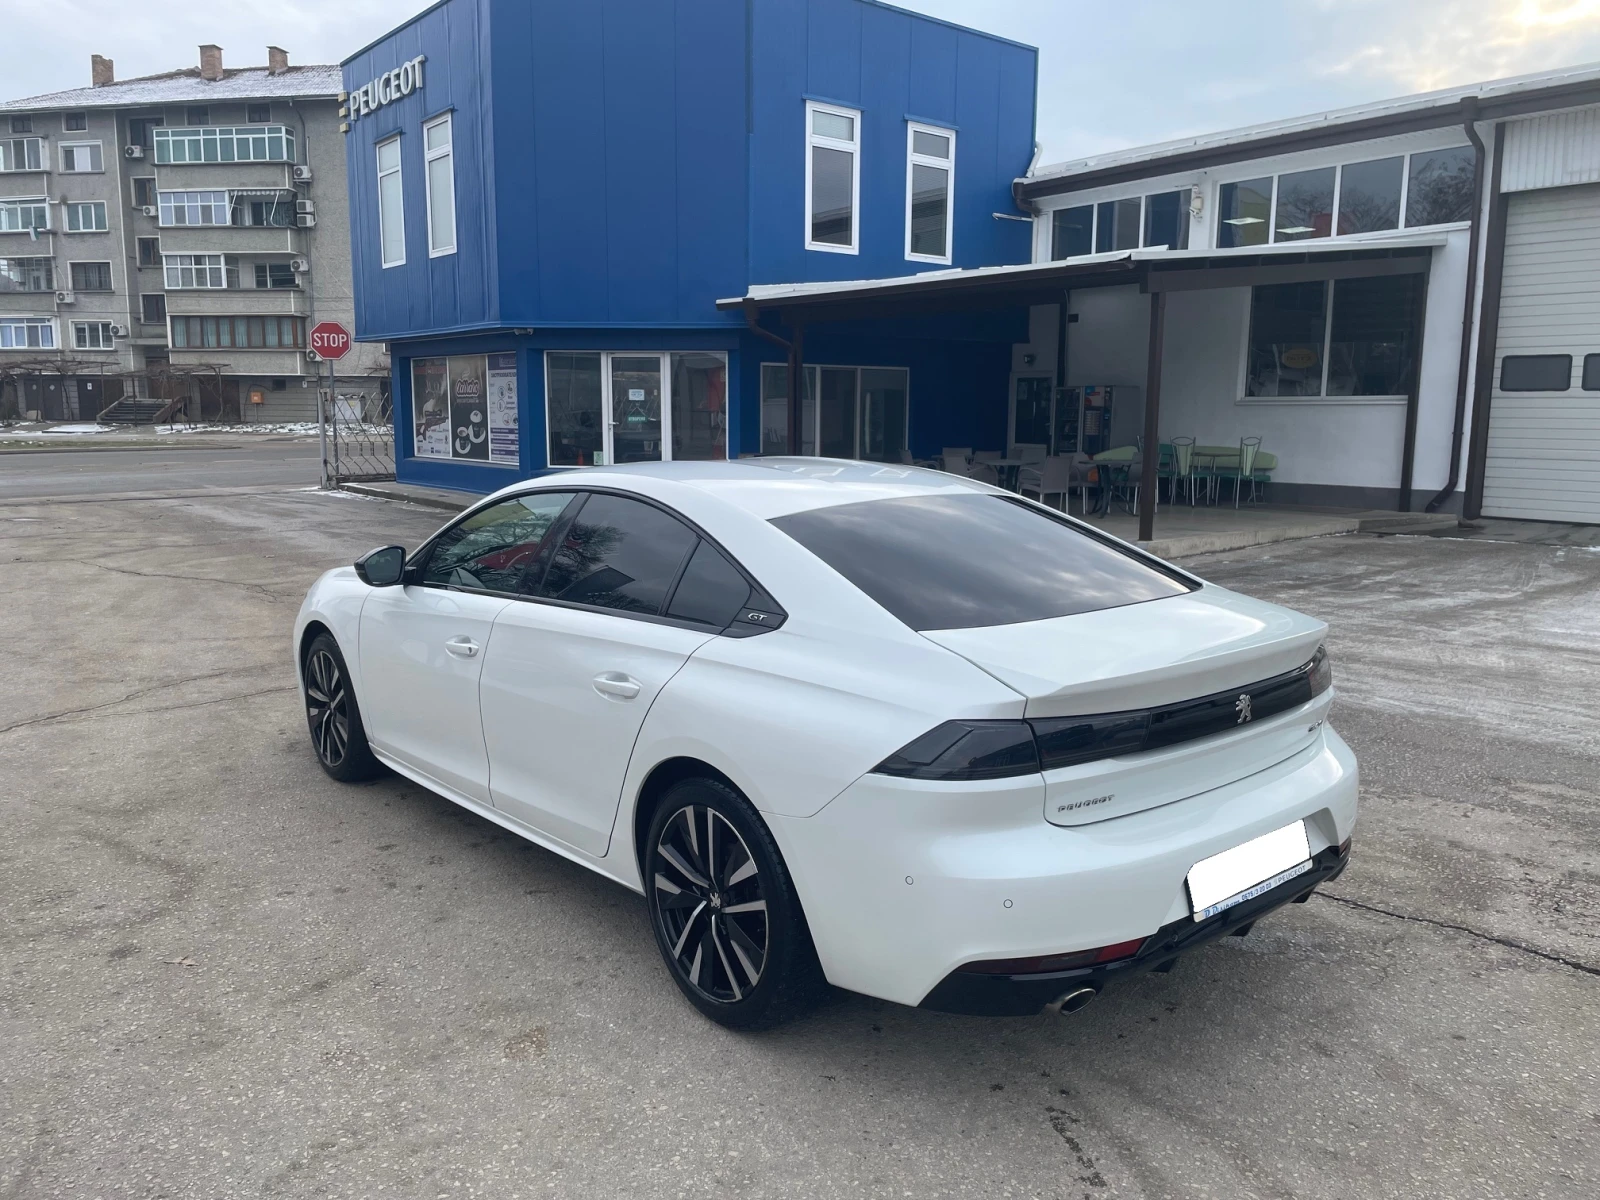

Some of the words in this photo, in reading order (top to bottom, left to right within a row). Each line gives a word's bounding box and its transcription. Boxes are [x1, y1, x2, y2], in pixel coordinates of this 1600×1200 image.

[349, 54, 425, 121] PEUGEOT
[313, 333, 347, 347] STOP
[748, 613, 768, 621] GT
[1057, 794, 1115, 812] PEUGEOT
[1277, 864, 1306, 884] PEUGEOT
